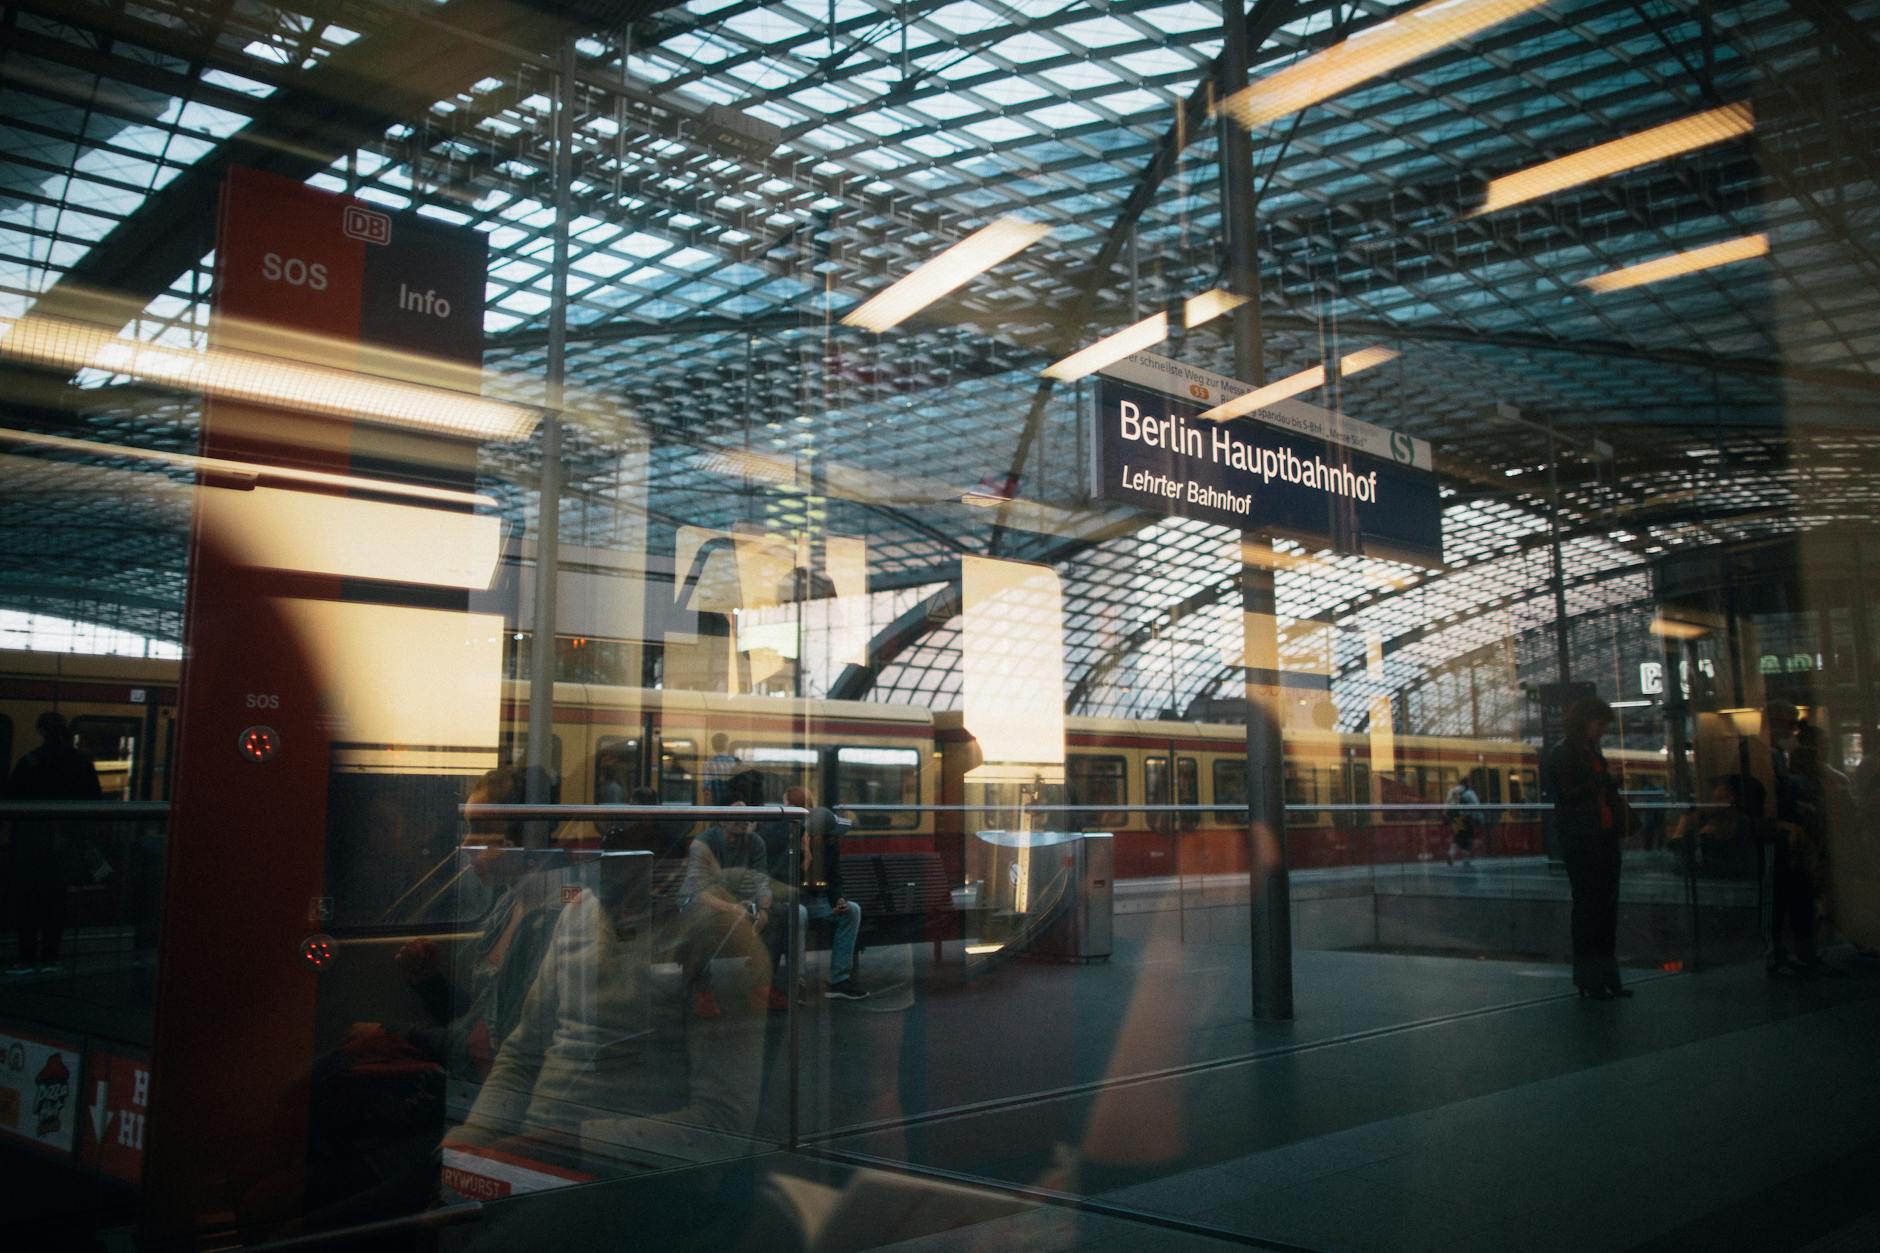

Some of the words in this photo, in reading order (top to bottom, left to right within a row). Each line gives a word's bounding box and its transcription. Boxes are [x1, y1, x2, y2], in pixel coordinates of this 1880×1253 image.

[349, 212, 387, 239] DB
[261, 252, 329, 291] SOS
[399, 283, 452, 318] Info
[1139, 355, 1184, 378] schnellste
[1184, 368, 1205, 386] Weg
[1205, 376, 1220, 388] zur
[1119, 399, 1203, 459] Berlin
[1211, 426, 1378, 503] Hauptbahnhof
[1391, 430, 1413, 466] S
[1121, 464, 1184, 500] Lehrter
[1187, 480, 1252, 516] Bahnhof
[246, 692, 280, 709] SOS
